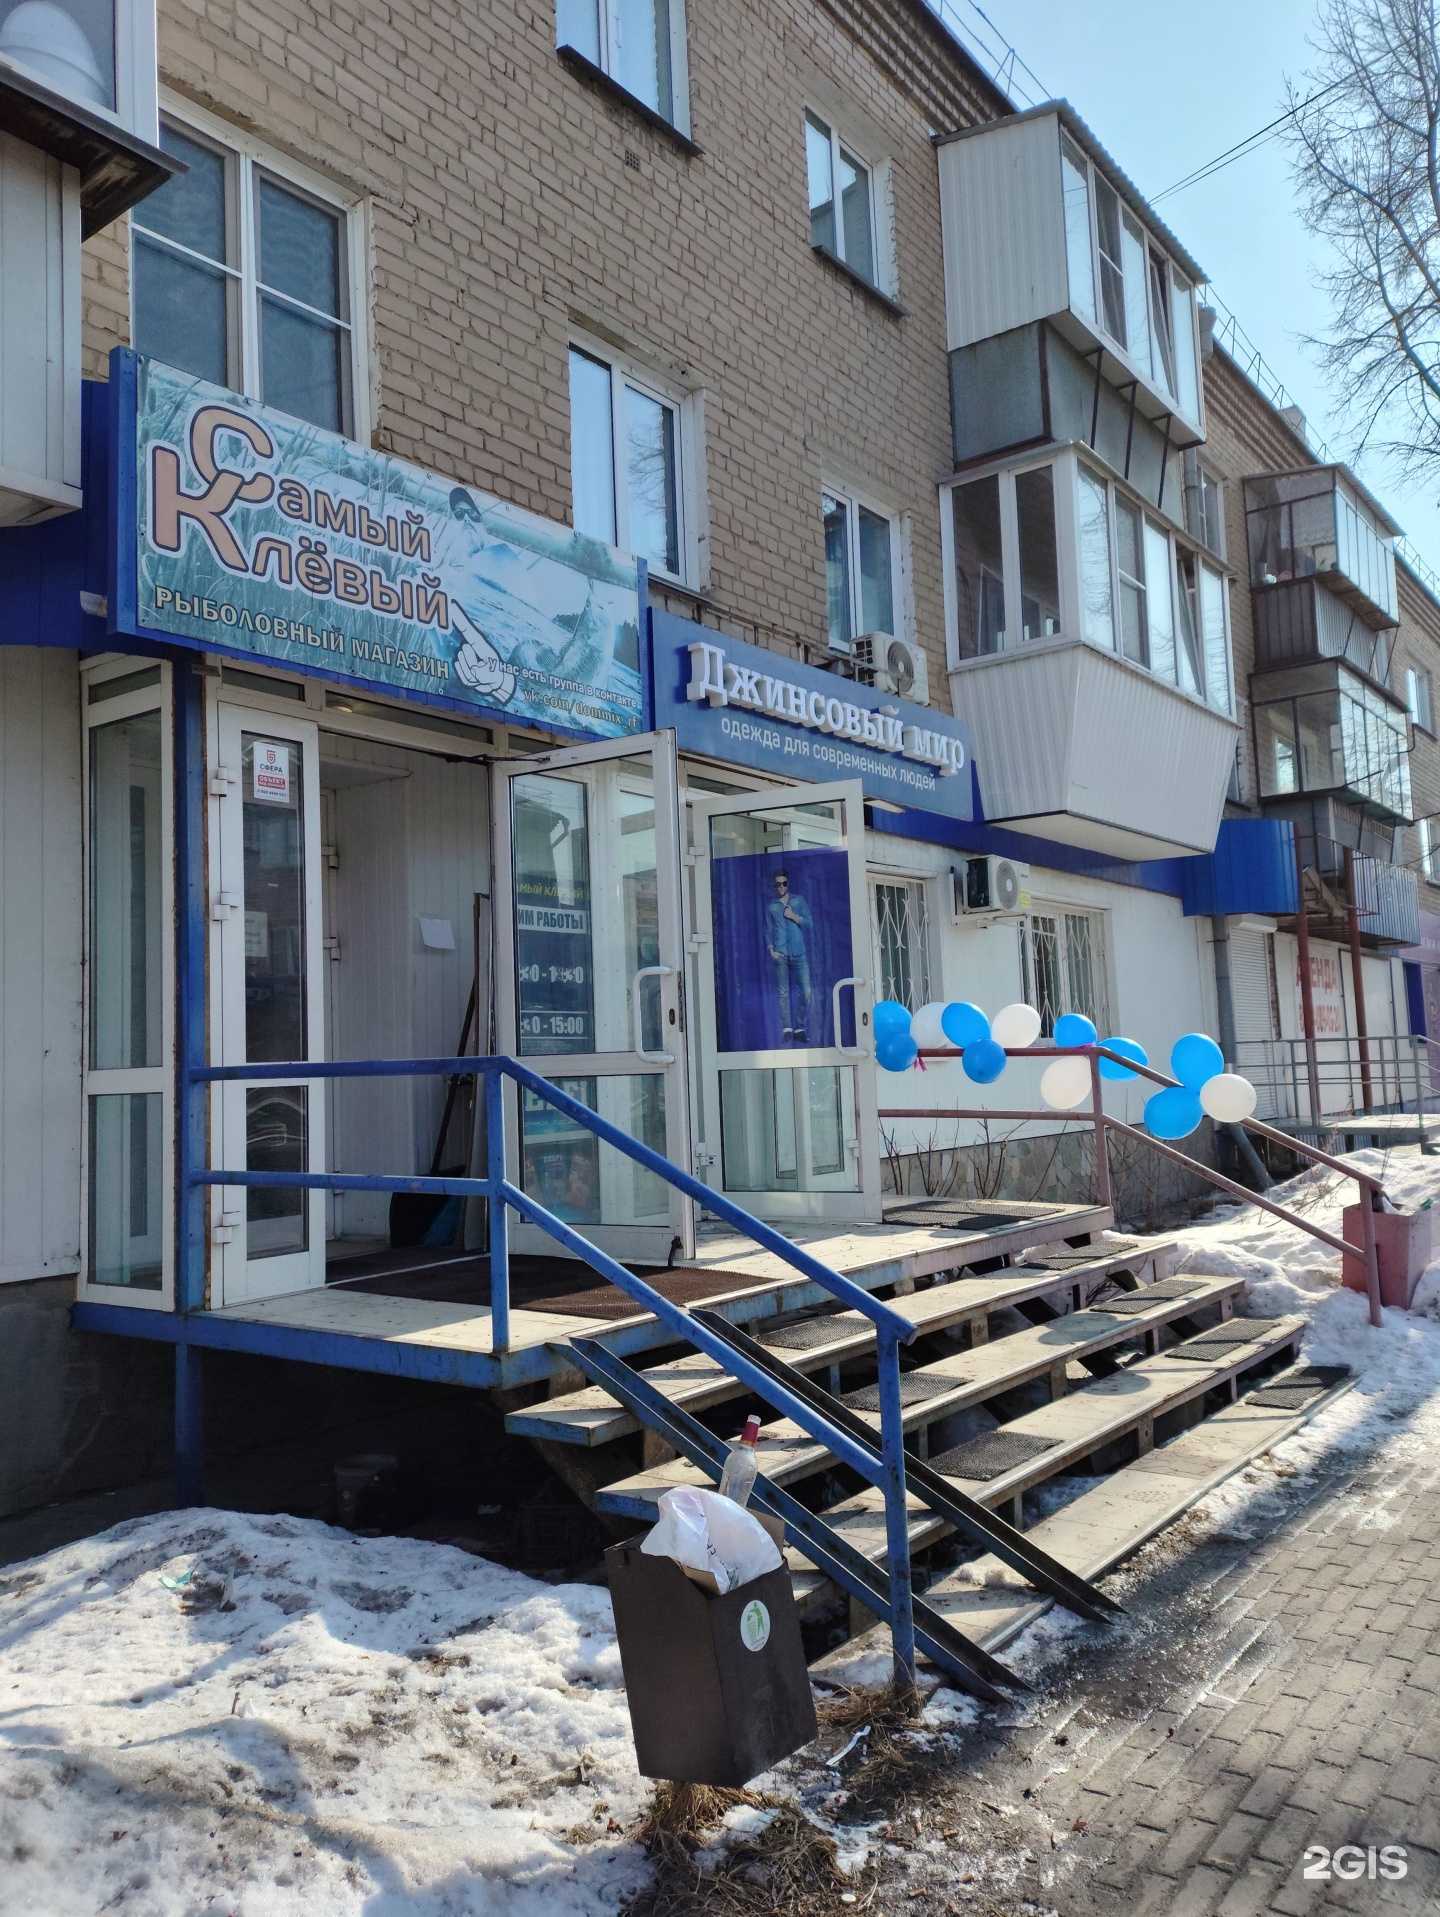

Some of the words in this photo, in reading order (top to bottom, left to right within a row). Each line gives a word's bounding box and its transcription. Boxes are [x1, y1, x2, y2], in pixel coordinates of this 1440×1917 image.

[190, 405, 432, 563] Самый
[151, 445, 449, 630] Клёвый
[154, 586, 345, 654] РЫБОЛОВНЫЙ
[351, 638, 449, 680] МАГАЗИН
[488, 656, 498, 672] у
[500, 661, 520, 676] нас
[521, 668, 547, 683] есть
[549, 675, 585, 694] группа
[595, 685, 637, 708] контакте
[260, 763, 284, 773] СФЕРА
[721, 717, 781, 749] одежда
[783, 735, 810, 757] для
[812, 743, 897, 782] современных
[898, 766, 936, 792] людей
[536, 910, 584, 930] РАБОТЫ
[549, 1016, 584, 1034] 15:00
